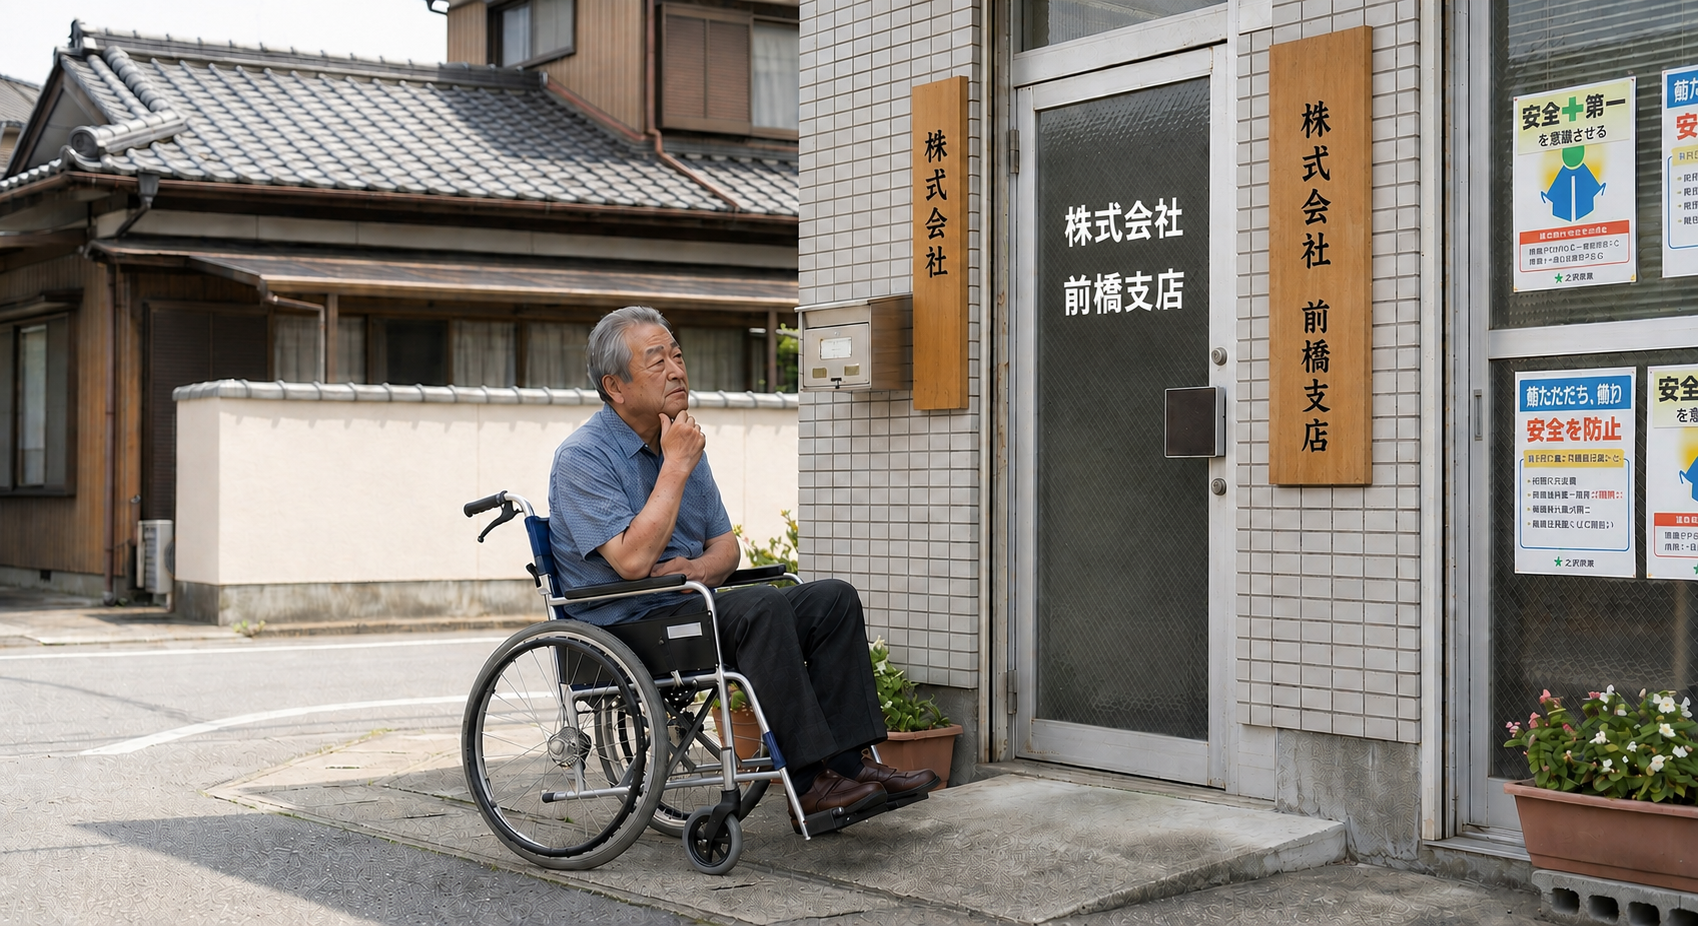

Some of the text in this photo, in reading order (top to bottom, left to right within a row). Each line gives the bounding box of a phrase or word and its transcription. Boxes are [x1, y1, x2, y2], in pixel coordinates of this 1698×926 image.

[924, 129, 948, 279] 株式会社
[1064, 197, 1184, 248] 株式会社
[1063, 267, 1185, 316] 前橋支店
[1300, 100, 1331, 453] 株式会社 前橋支店
[1658, 375, 1698, 403] 安全
[1527, 415, 1622, 443] 安全を防止
